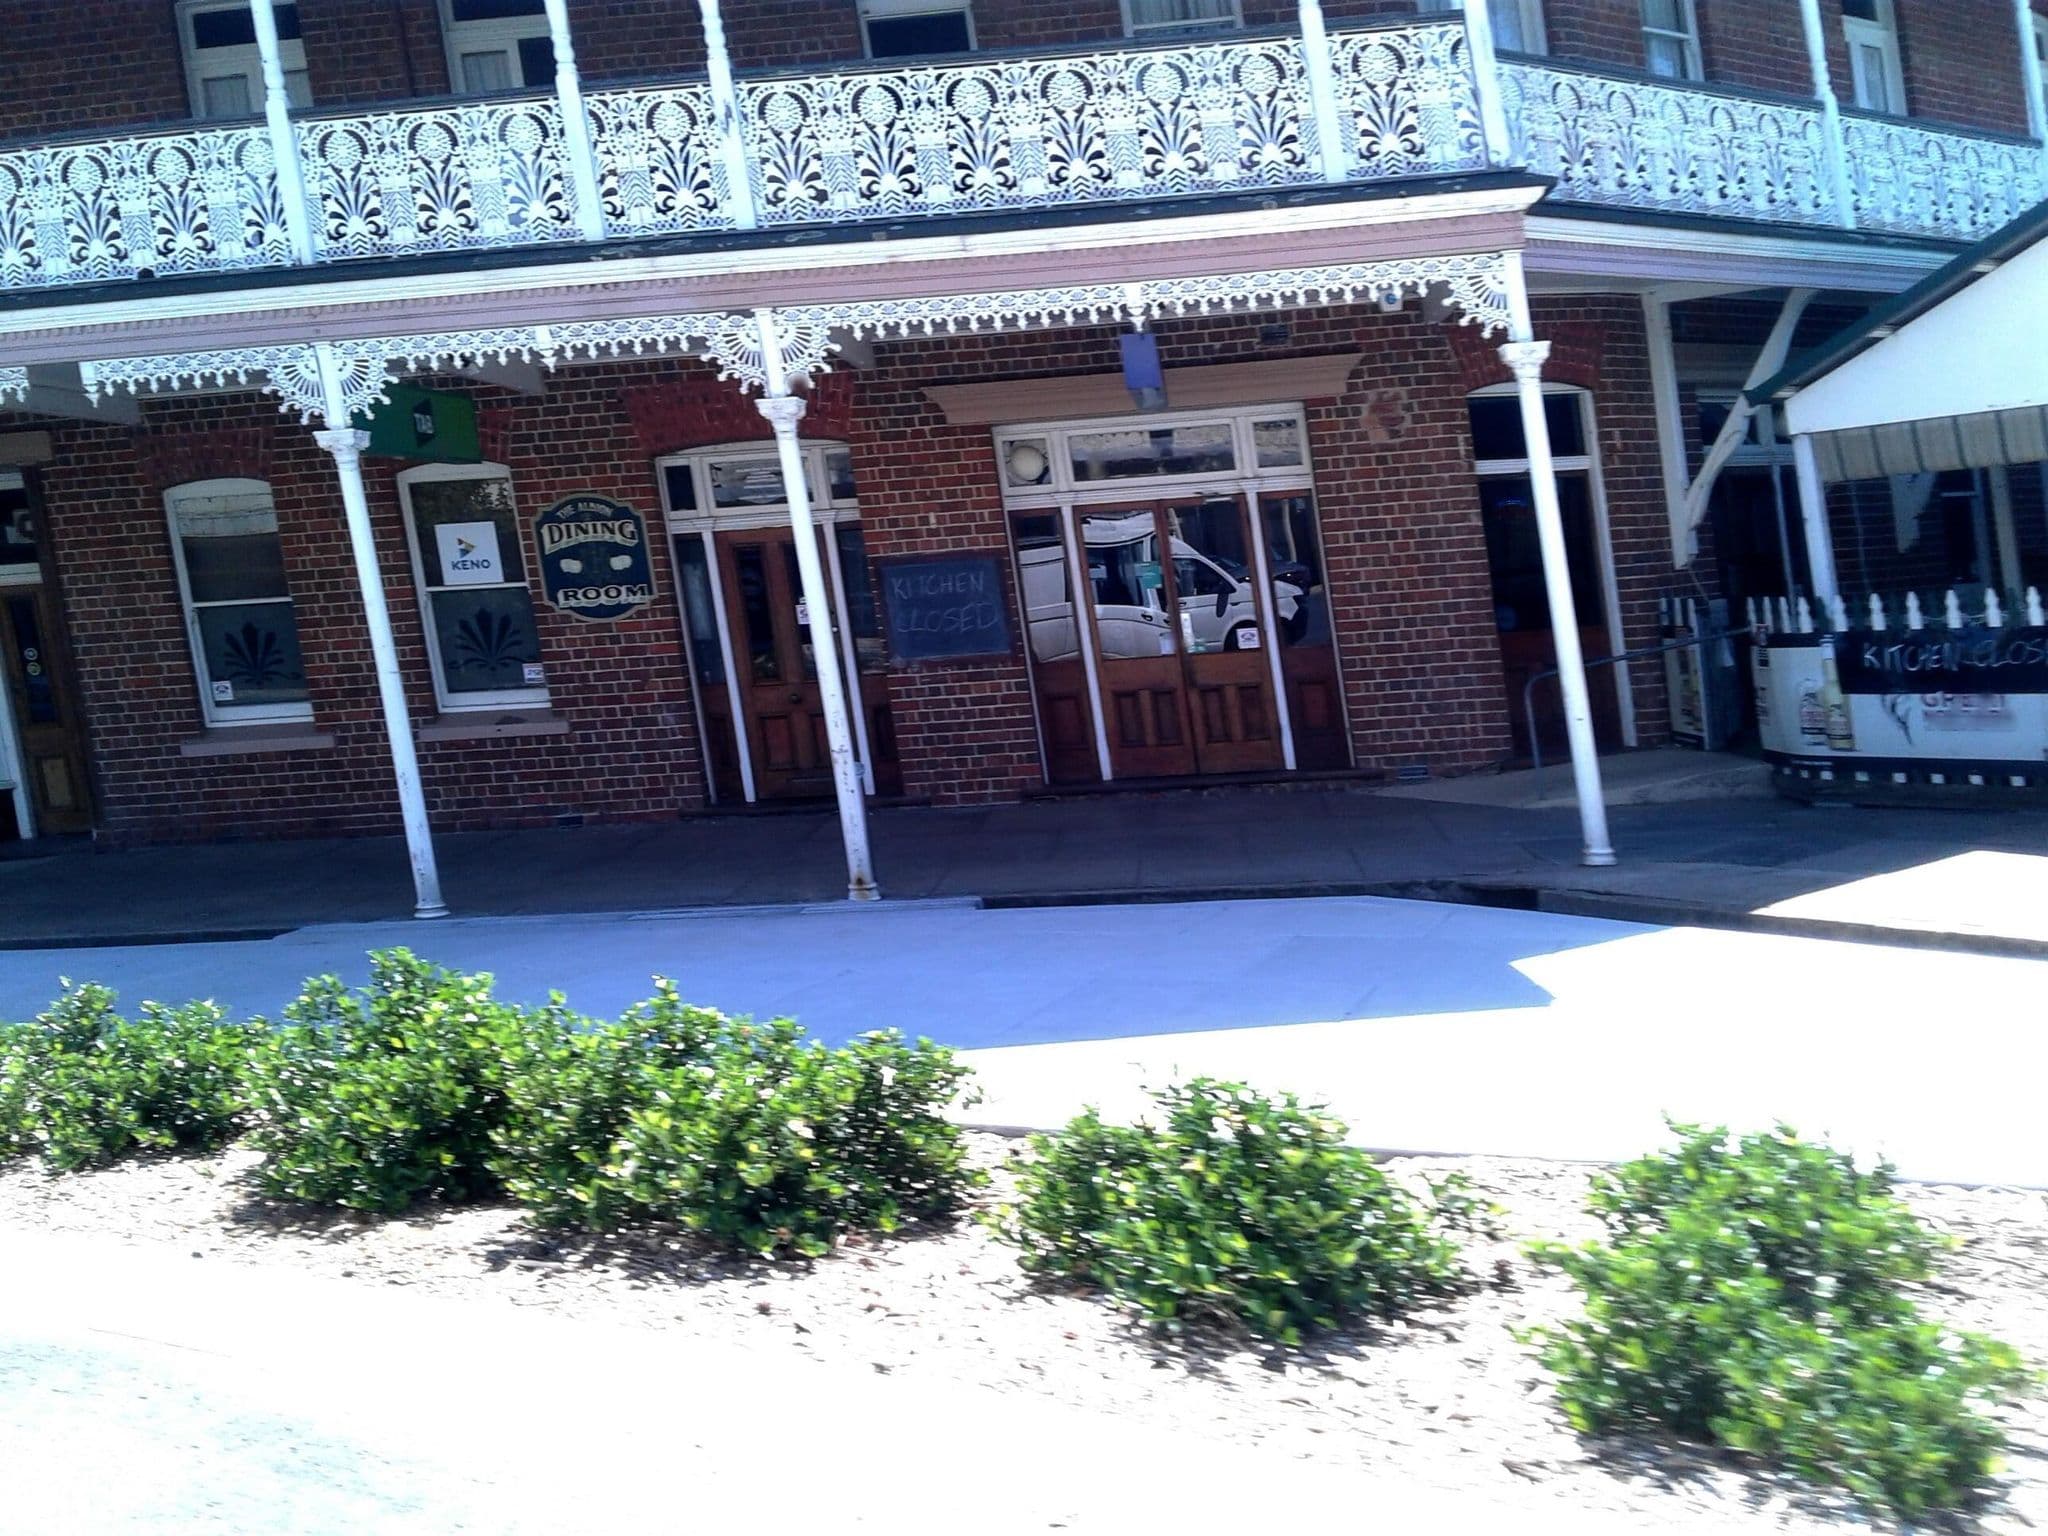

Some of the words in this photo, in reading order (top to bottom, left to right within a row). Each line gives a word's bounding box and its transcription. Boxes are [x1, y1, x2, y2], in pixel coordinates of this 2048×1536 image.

[543, 520, 638, 549] DINING
[451, 559, 491, 571] KENO
[559, 584, 649, 606] ROOM
[891, 570, 985, 600] KITCHEN
[897, 602, 1000, 632] CLOSED
[1863, 642, 1960, 672] KITCHEN
